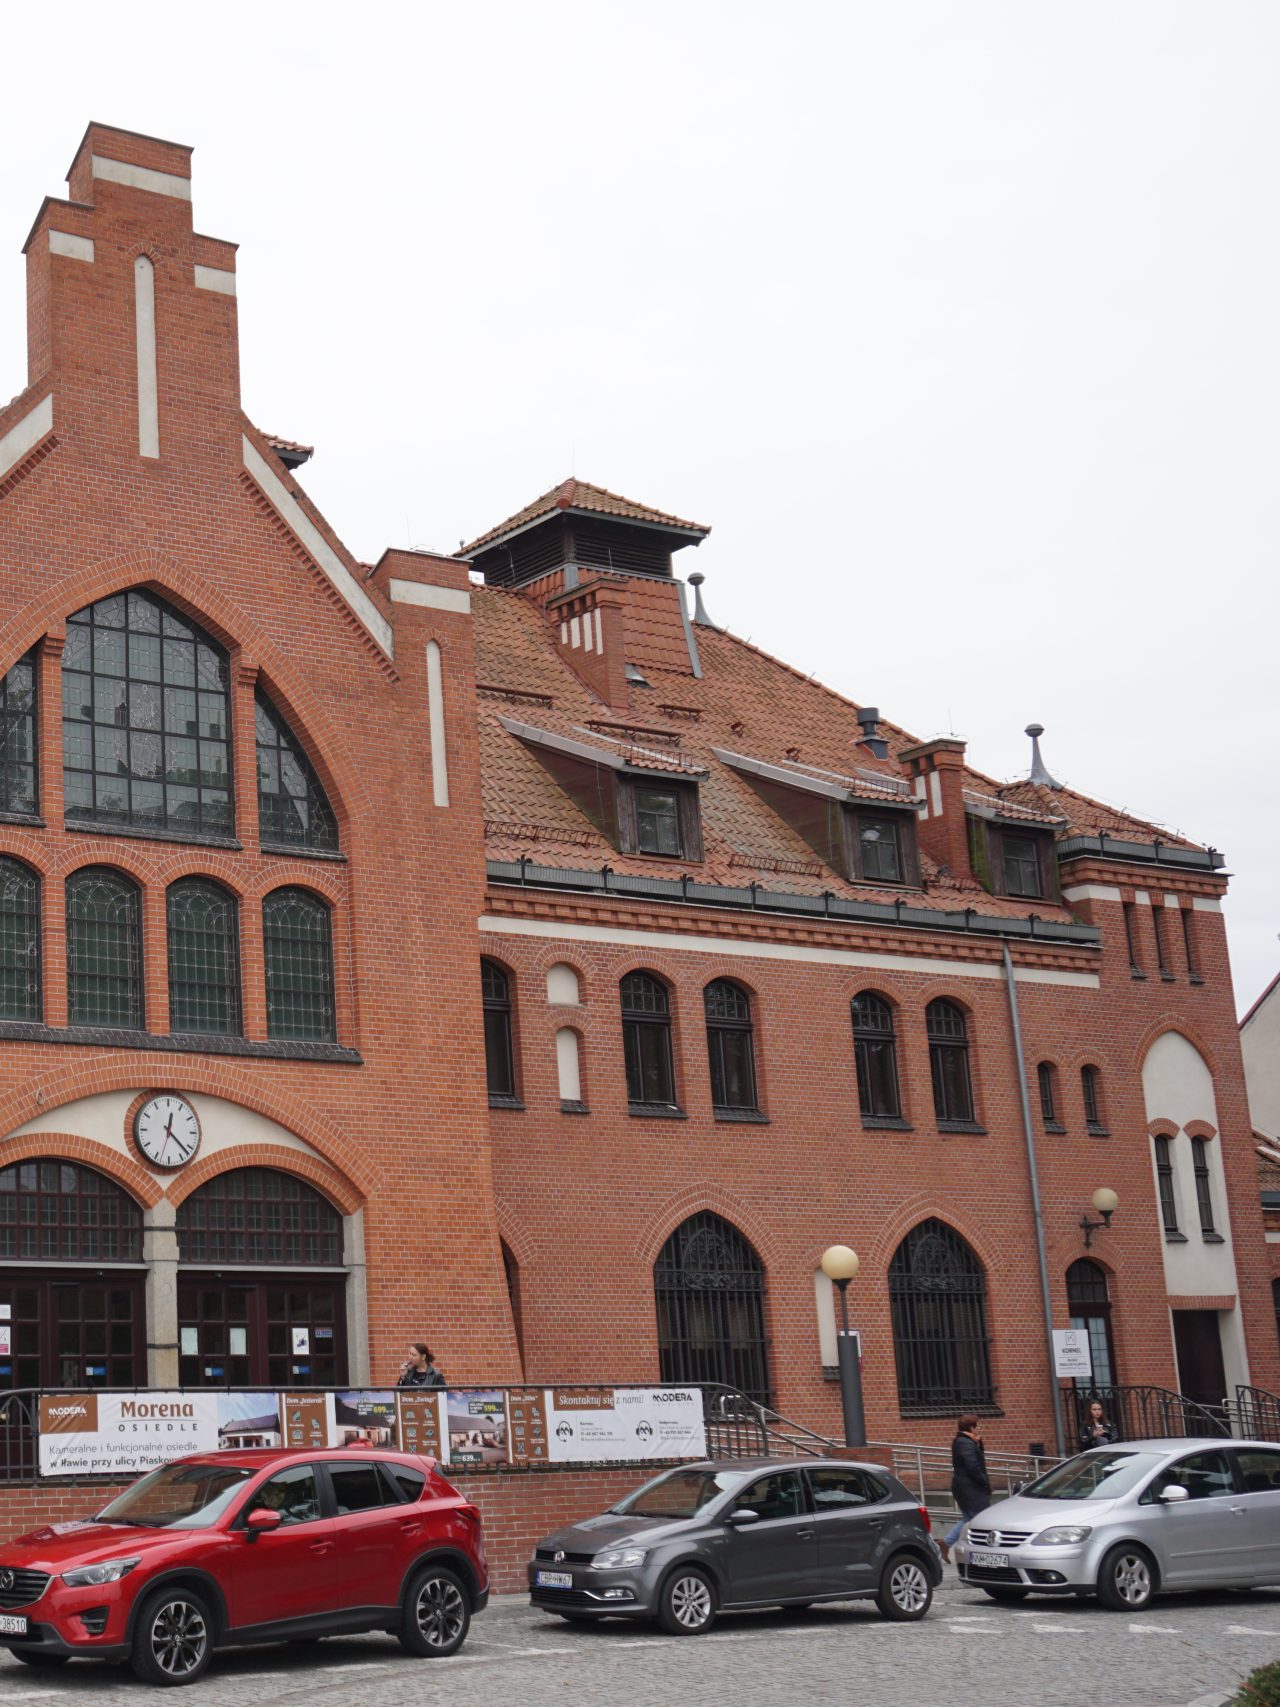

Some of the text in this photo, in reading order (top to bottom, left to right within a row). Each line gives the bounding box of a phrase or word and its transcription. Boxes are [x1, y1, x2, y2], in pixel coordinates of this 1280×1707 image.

[559, 1394, 601, 1407] Skontaktuj
[602, 1394, 615, 1407] się
[622, 1394, 644, 1405] nami!
[652, 1393, 694, 1403] MODERA
[48, 1406, 87, 1416] MODERA
[120, 1401, 194, 1418] Morena
[373, 1405, 387, 1414] 699
[483, 1404, 497, 1412] 599
[118, 1423, 199, 1432] OSIEDLE
[49, 1443, 97, 1455] Kameralne
[106, 1442, 163, 1455] funkcjonalne
[166, 1441, 198, 1452] osiedle
[61, 1457, 89, 1467] Iławie
[91, 1458, 112, 1469] przy
[115, 1456, 137, 1467] ulicy
[462, 1454, 474, 1462] 639
[2, 1617, 26, 1632] 38510
